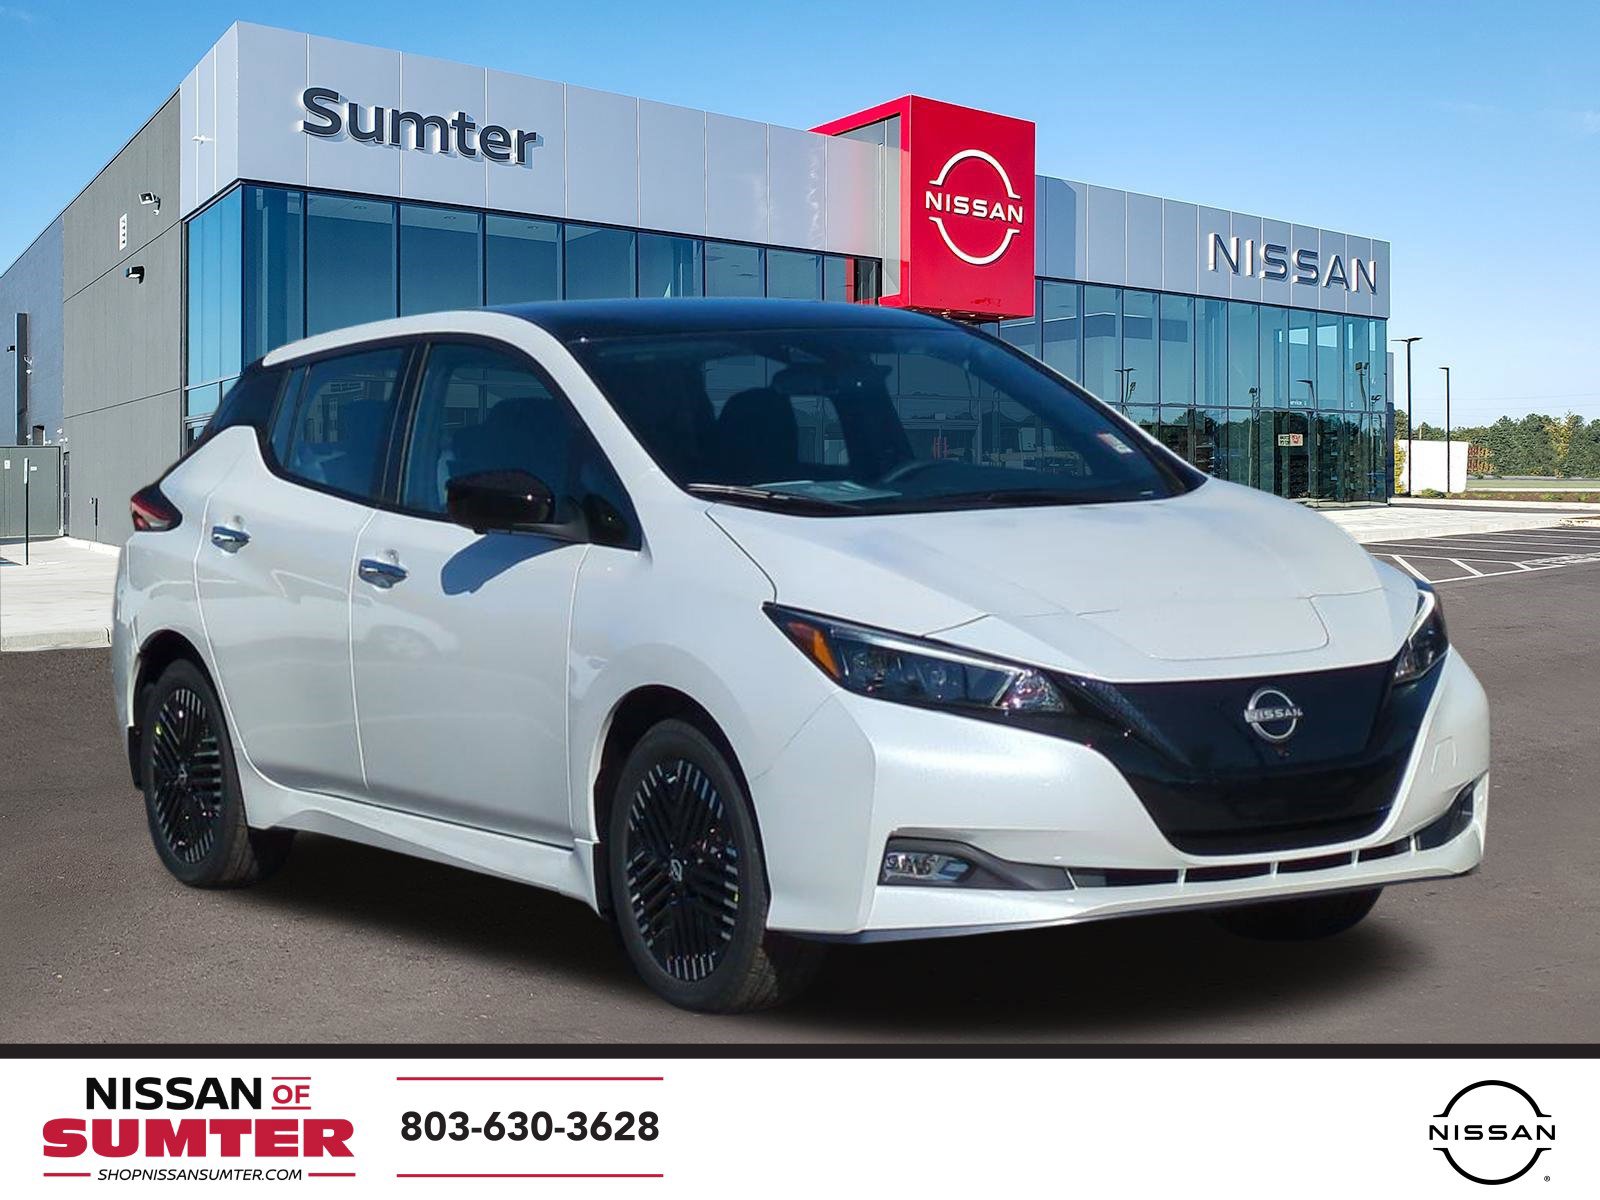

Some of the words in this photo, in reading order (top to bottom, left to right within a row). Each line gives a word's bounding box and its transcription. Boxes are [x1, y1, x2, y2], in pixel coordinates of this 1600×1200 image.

[301, 86, 541, 167] Sumter
[925, 190, 1024, 224] NISSAN
[1208, 232, 1378, 294] NISSAN
[1244, 708, 1303, 722] NISSAN
